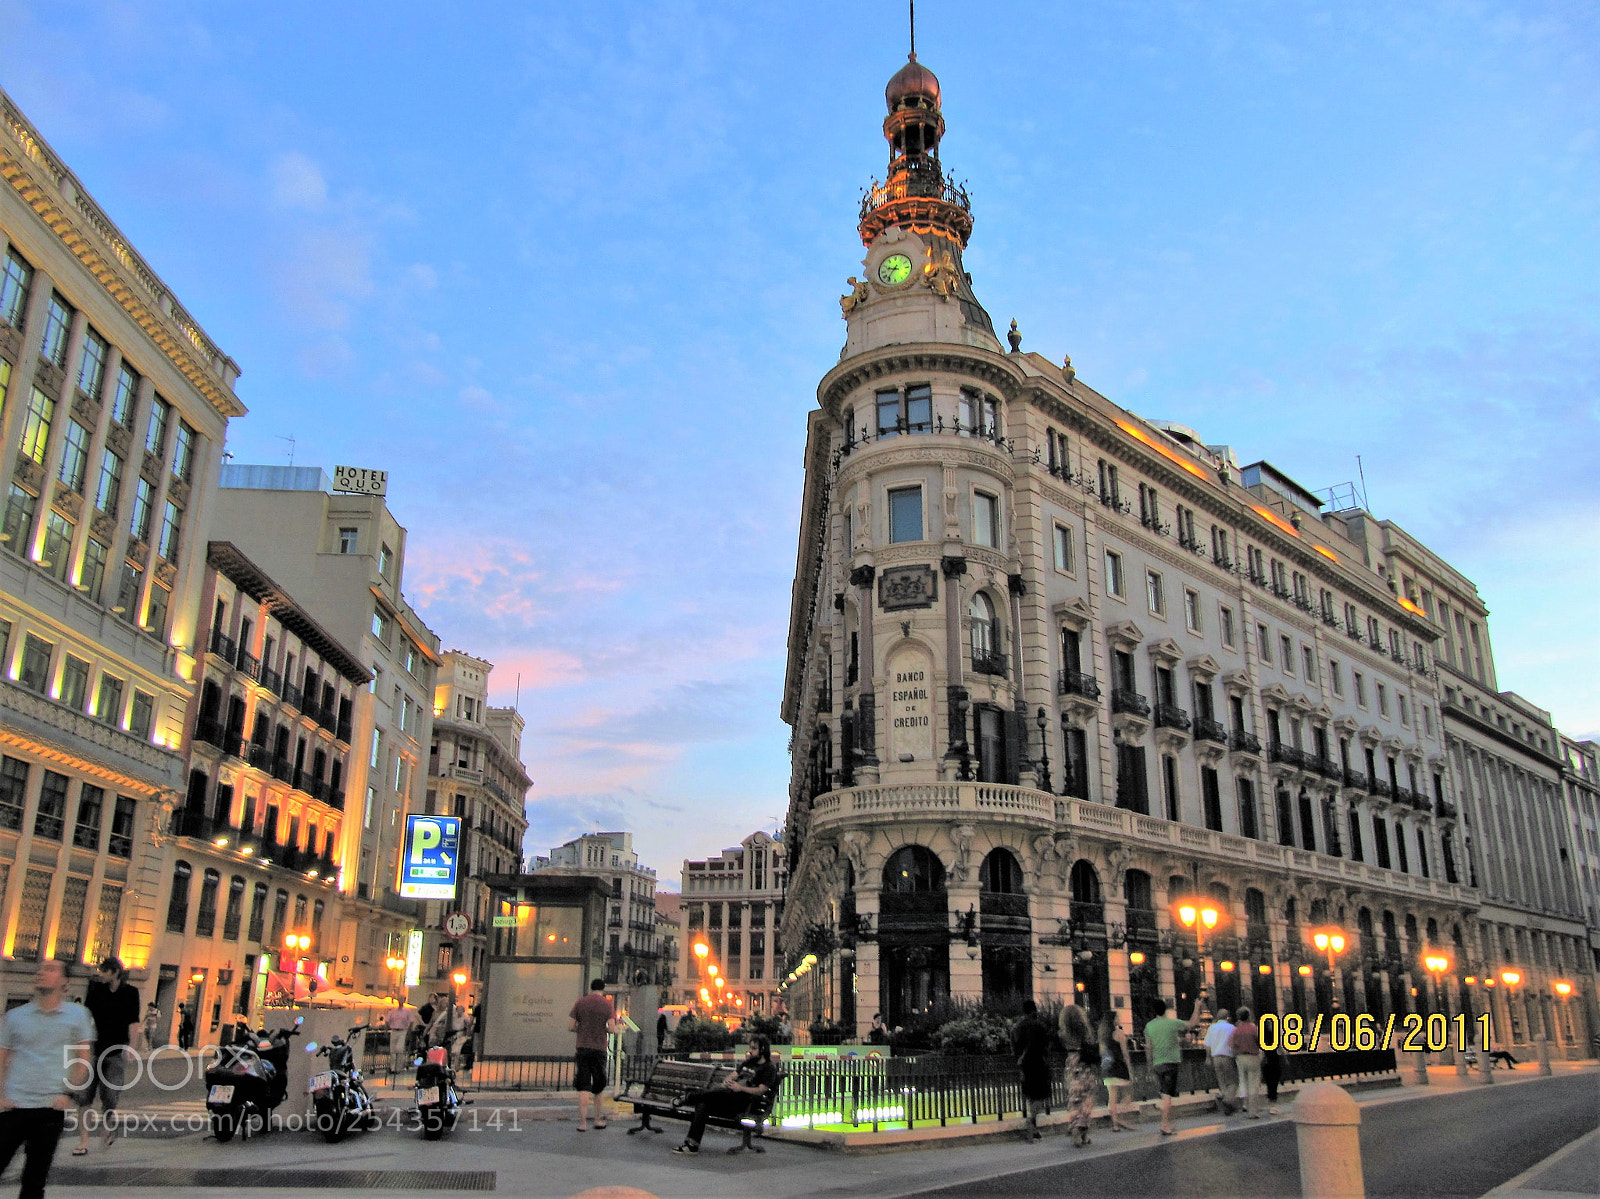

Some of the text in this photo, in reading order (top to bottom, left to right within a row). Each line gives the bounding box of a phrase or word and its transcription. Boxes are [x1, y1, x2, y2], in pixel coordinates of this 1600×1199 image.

[336, 466, 386, 482] HOTEL
[340, 477, 381, 490] QUO
[896, 671, 924, 683] BANCO
[893, 687, 928, 701] ESPAÑOL
[894, 715, 929, 728] CREDITO
[411, 821, 441, 864] P
